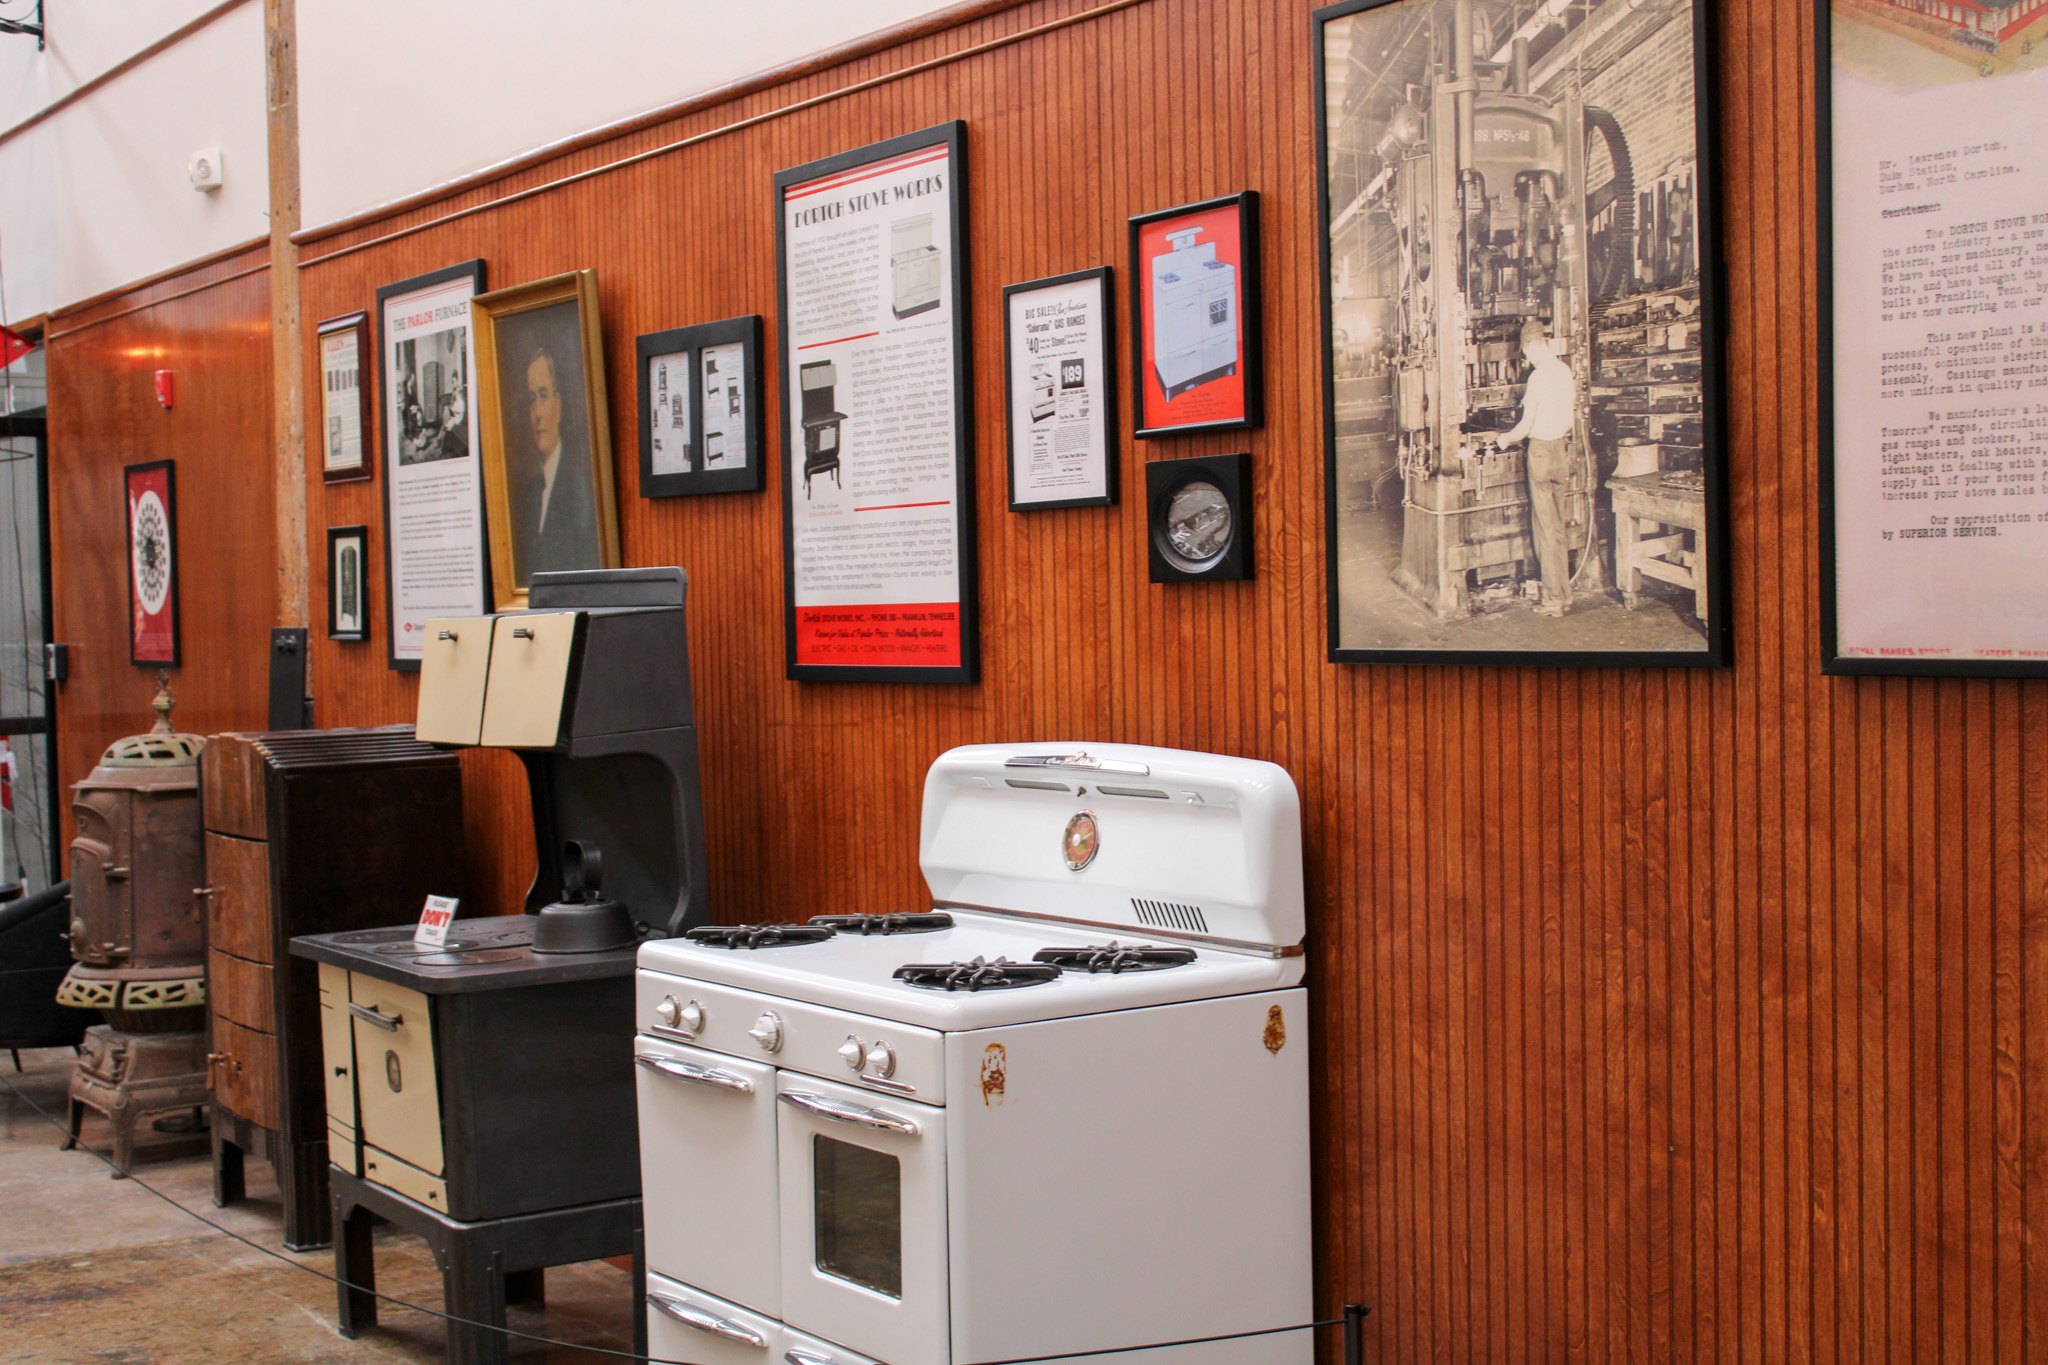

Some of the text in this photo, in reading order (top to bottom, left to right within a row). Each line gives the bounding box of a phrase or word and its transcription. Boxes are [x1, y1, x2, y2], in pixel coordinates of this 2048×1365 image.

[1879, 161, 1896, 170] Mr.
[1909, 150, 1957, 165] Lawrence
[1880, 163, 1957, 182] Duke Station,
[1880, 166, 2020, 194] Durham, North Carolina.
[795, 174, 942, 228] DORTCH STOVE WORKS
[1926, 213, 2048, 239] The DORTCH STOVE WO
[1883, 248, 1900, 257] the
[1906, 244, 1935, 255] stove
[1943, 236, 1992, 250] industry
[2024, 229, 2044, 239] new
[1882, 241, 2048, 272] patterns, new machinery, ne
[1882, 273, 1893, 283] We
[1899, 271, 1923, 281] have
[1930, 264, 1978, 278] acquired
[1985, 260, 2003, 270] all
[2010, 257, 2023, 267] of
[1882, 270, 2042, 296] Works, and have bought the
[1882, 298, 1911, 309] built
[1917, 296, 1929, 305] at
[1935, 290, 1989, 303] Franklin,
[1998, 285, 2028, 296] Tenn.
[407, 310, 434, 328] PARLOR
[435, 302, 468, 321] FURNACE
[1025, 308, 1035, 319] BIG
[1882, 296, 2042, 322] we are now carrying on our
[1054, 318, 1064, 329] GAS
[1067, 315, 1085, 327] RANGES
[1927, 333, 1951, 343] This
[1958, 330, 1977, 340] new
[1982, 326, 2013, 340] plant
[2021, 324, 2033, 334] is
[1882, 346, 1941, 360] successful
[1947, 341, 2004, 356] operation
[2010, 338, 2023, 348] of
[1881, 349, 2048, 375] process, continuous electri
[1881, 363, 2048, 386] assembly. Castings manufac
[1881, 376, 2048, 398] more uniform in quality and
[1929, 411, 1941, 421] We
[1947, 406, 2016, 420] manufacture
[2023, 406, 2029, 414] a
[1941, 422, 1983, 435] ranges,
[1991, 417, 2048, 430] circulati
[1881, 431, 2048, 452] gas ranges and cookers, lau
[1882, 446, 2047, 464] tight heaters, oak heaters,
[1882, 465, 1934, 475] advantage
[1941, 463, 1953, 472] in
[1959, 461, 2004, 472] dealing
[2009, 458, 2035, 469] with
[1882, 477, 1917, 489] supply
[1923, 475, 1940, 486] all
[1947, 475, 1959, 485] of
[1965, 474, 1990, 486] your
[1997, 472, 2035, 483] stoves
[1882, 491, 1928, 500] increase
[1934, 489, 1959, 500] your
[1965, 487, 1997, 497] stove
[2003, 485, 2035, 496] sales
[1931, 515, 1949, 525] Our
[1955, 513, 2031, 526] appreciation
[1882, 526, 2002, 540] by SUPERIOR SERVICE.
[422, 910, 451, 928] DON'T
